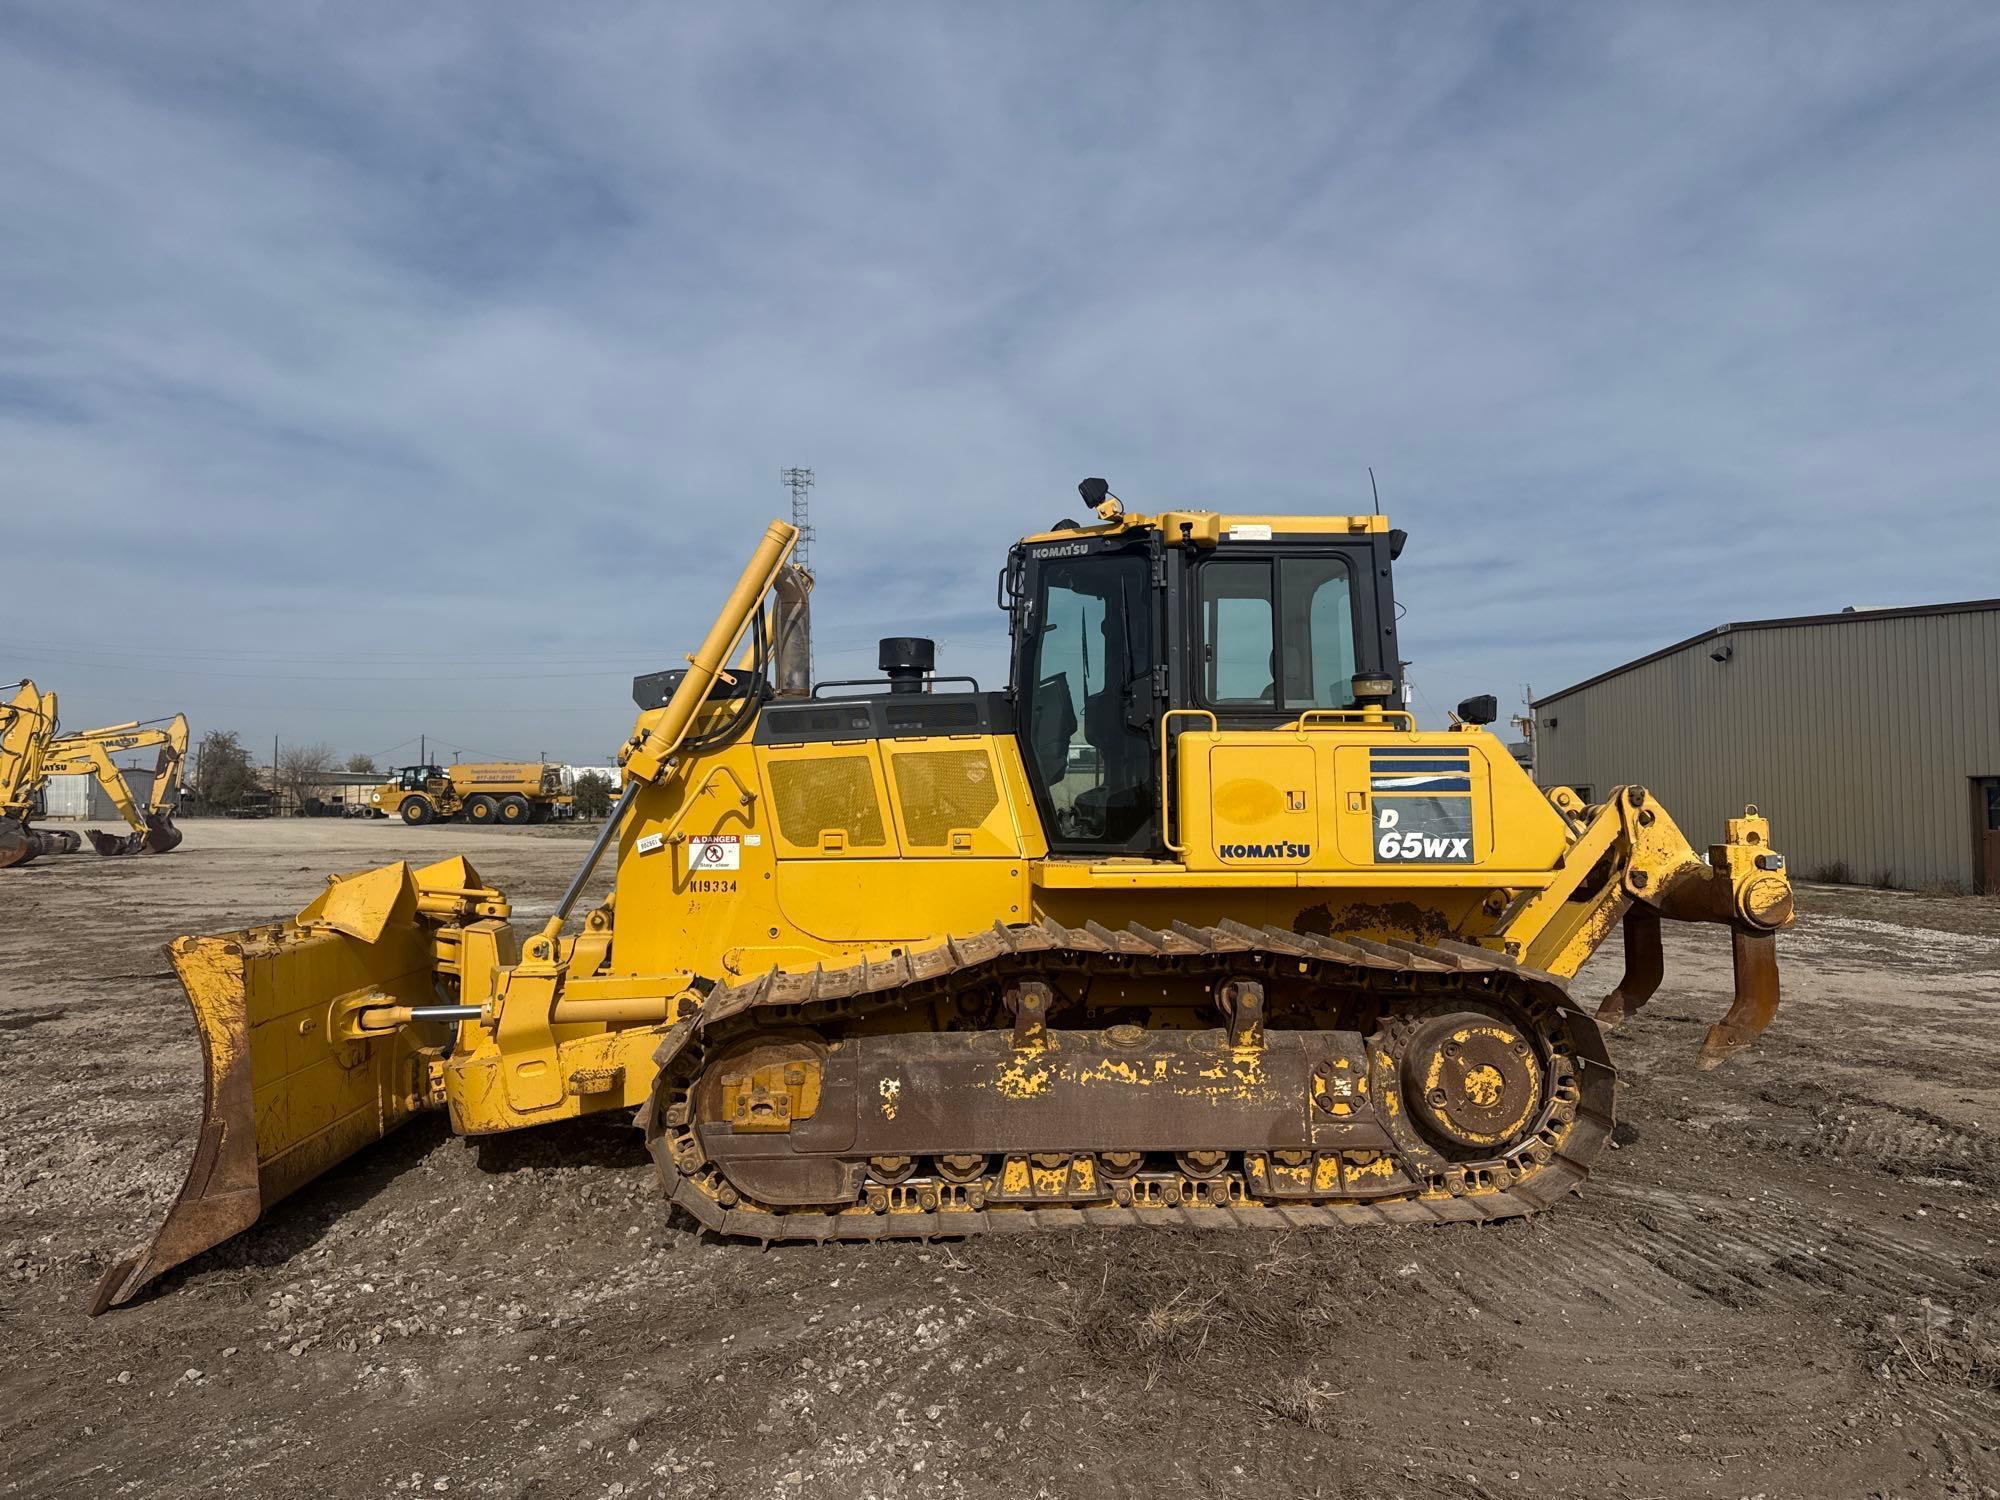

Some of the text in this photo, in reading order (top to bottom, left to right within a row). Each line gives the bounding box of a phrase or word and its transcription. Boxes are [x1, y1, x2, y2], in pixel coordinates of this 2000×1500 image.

[1032, 543, 1089, 558] KOMATSU
[97, 737, 139, 747] OMATSU
[1379, 809, 1399, 829] D
[1220, 841, 1310, 859] KOMATSU
[1378, 832, 1470, 859] 65WX
[690, 880, 736, 892] K19334
